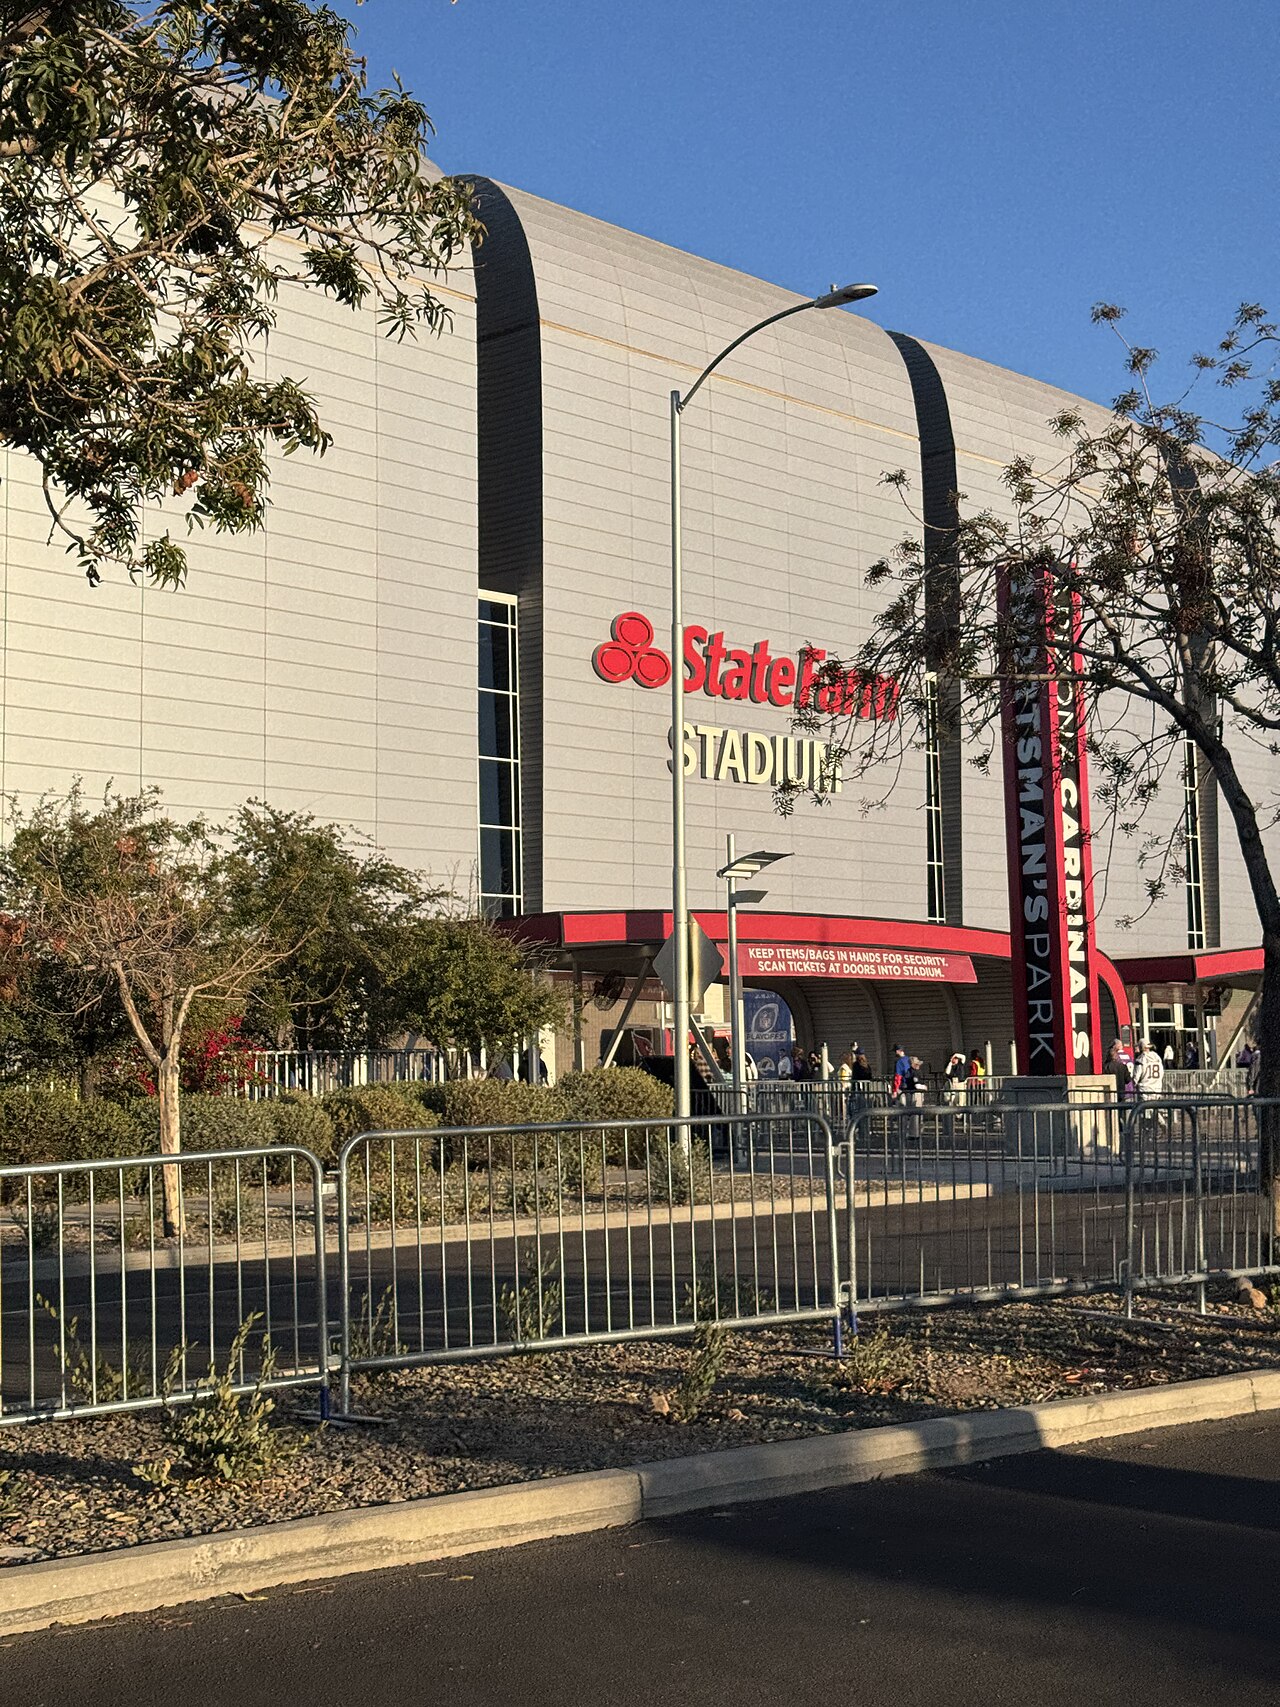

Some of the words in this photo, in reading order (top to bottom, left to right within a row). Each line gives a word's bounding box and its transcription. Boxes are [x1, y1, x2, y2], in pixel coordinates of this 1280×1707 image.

[669, 722, 842, 793] STADIUM
[1060, 777, 1090, 1060] CARDINALS
[748, 948, 774, 959] KEEP
[777, 949, 835, 961] ITEMS/BAGS
[837, 950, 847, 960] IN
[849, 951, 882, 963] HANDS
[883, 953, 903, 964] FOR
[904, 954, 949, 967] SECURITY.
[757, 961, 786, 972] SCAN
[787, 962, 826, 973] TICKETS
[829, 963, 841, 973] AT
[844, 963, 876, 975] DOORS
[878, 964, 901, 975] INTO
[903, 965, 945, 978] STADIUM.
[1024, 934, 1056, 1060] PARK
[1147, 1064, 1160, 1079] 18
